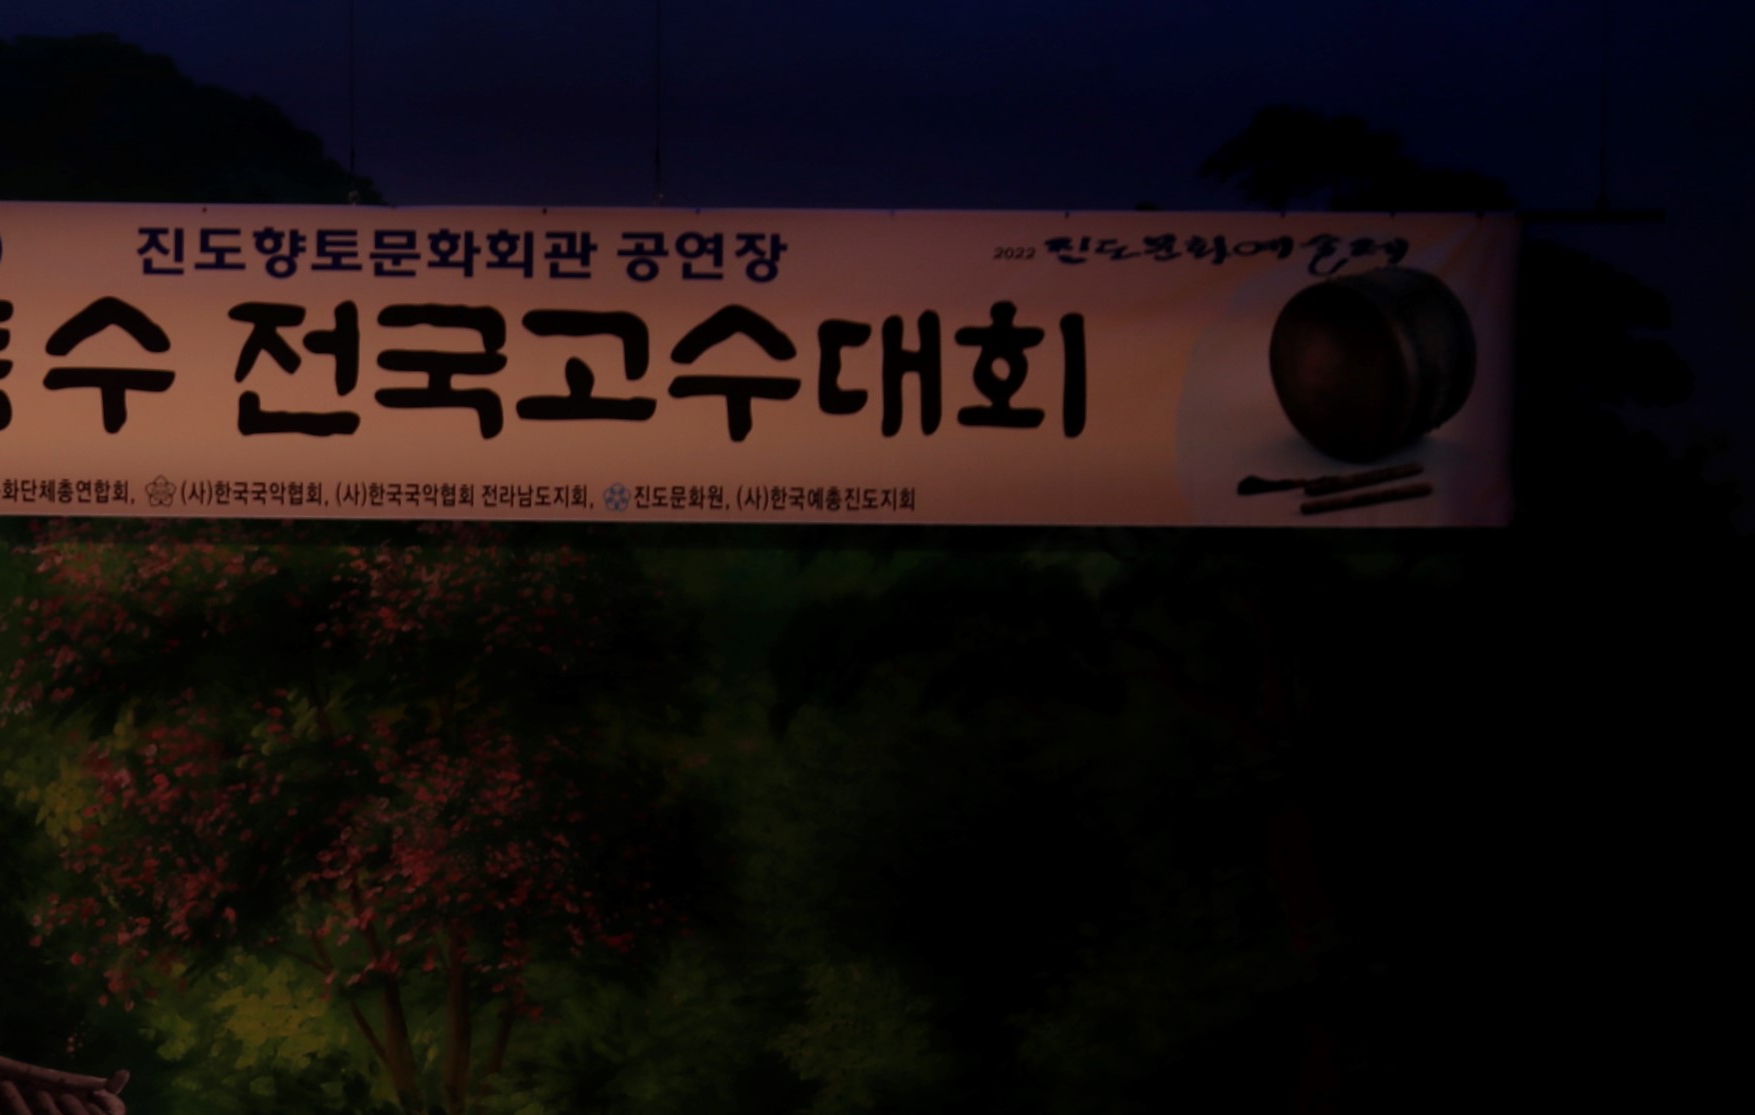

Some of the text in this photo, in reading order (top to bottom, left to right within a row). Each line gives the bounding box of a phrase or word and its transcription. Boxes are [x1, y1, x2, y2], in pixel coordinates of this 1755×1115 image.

[136, 227, 788, 282] 진도향토문화회관 공연장
[993, 247, 1037, 260] 2022
[228, 299, 1087, 441] 전국고수대회
[335, 482, 474, 509] (사)한국국악협회
[481, 484, 594, 510] 전라남도지회,
[634, 485, 916, 512] 진도문화원, (사)한국예총진도지회
